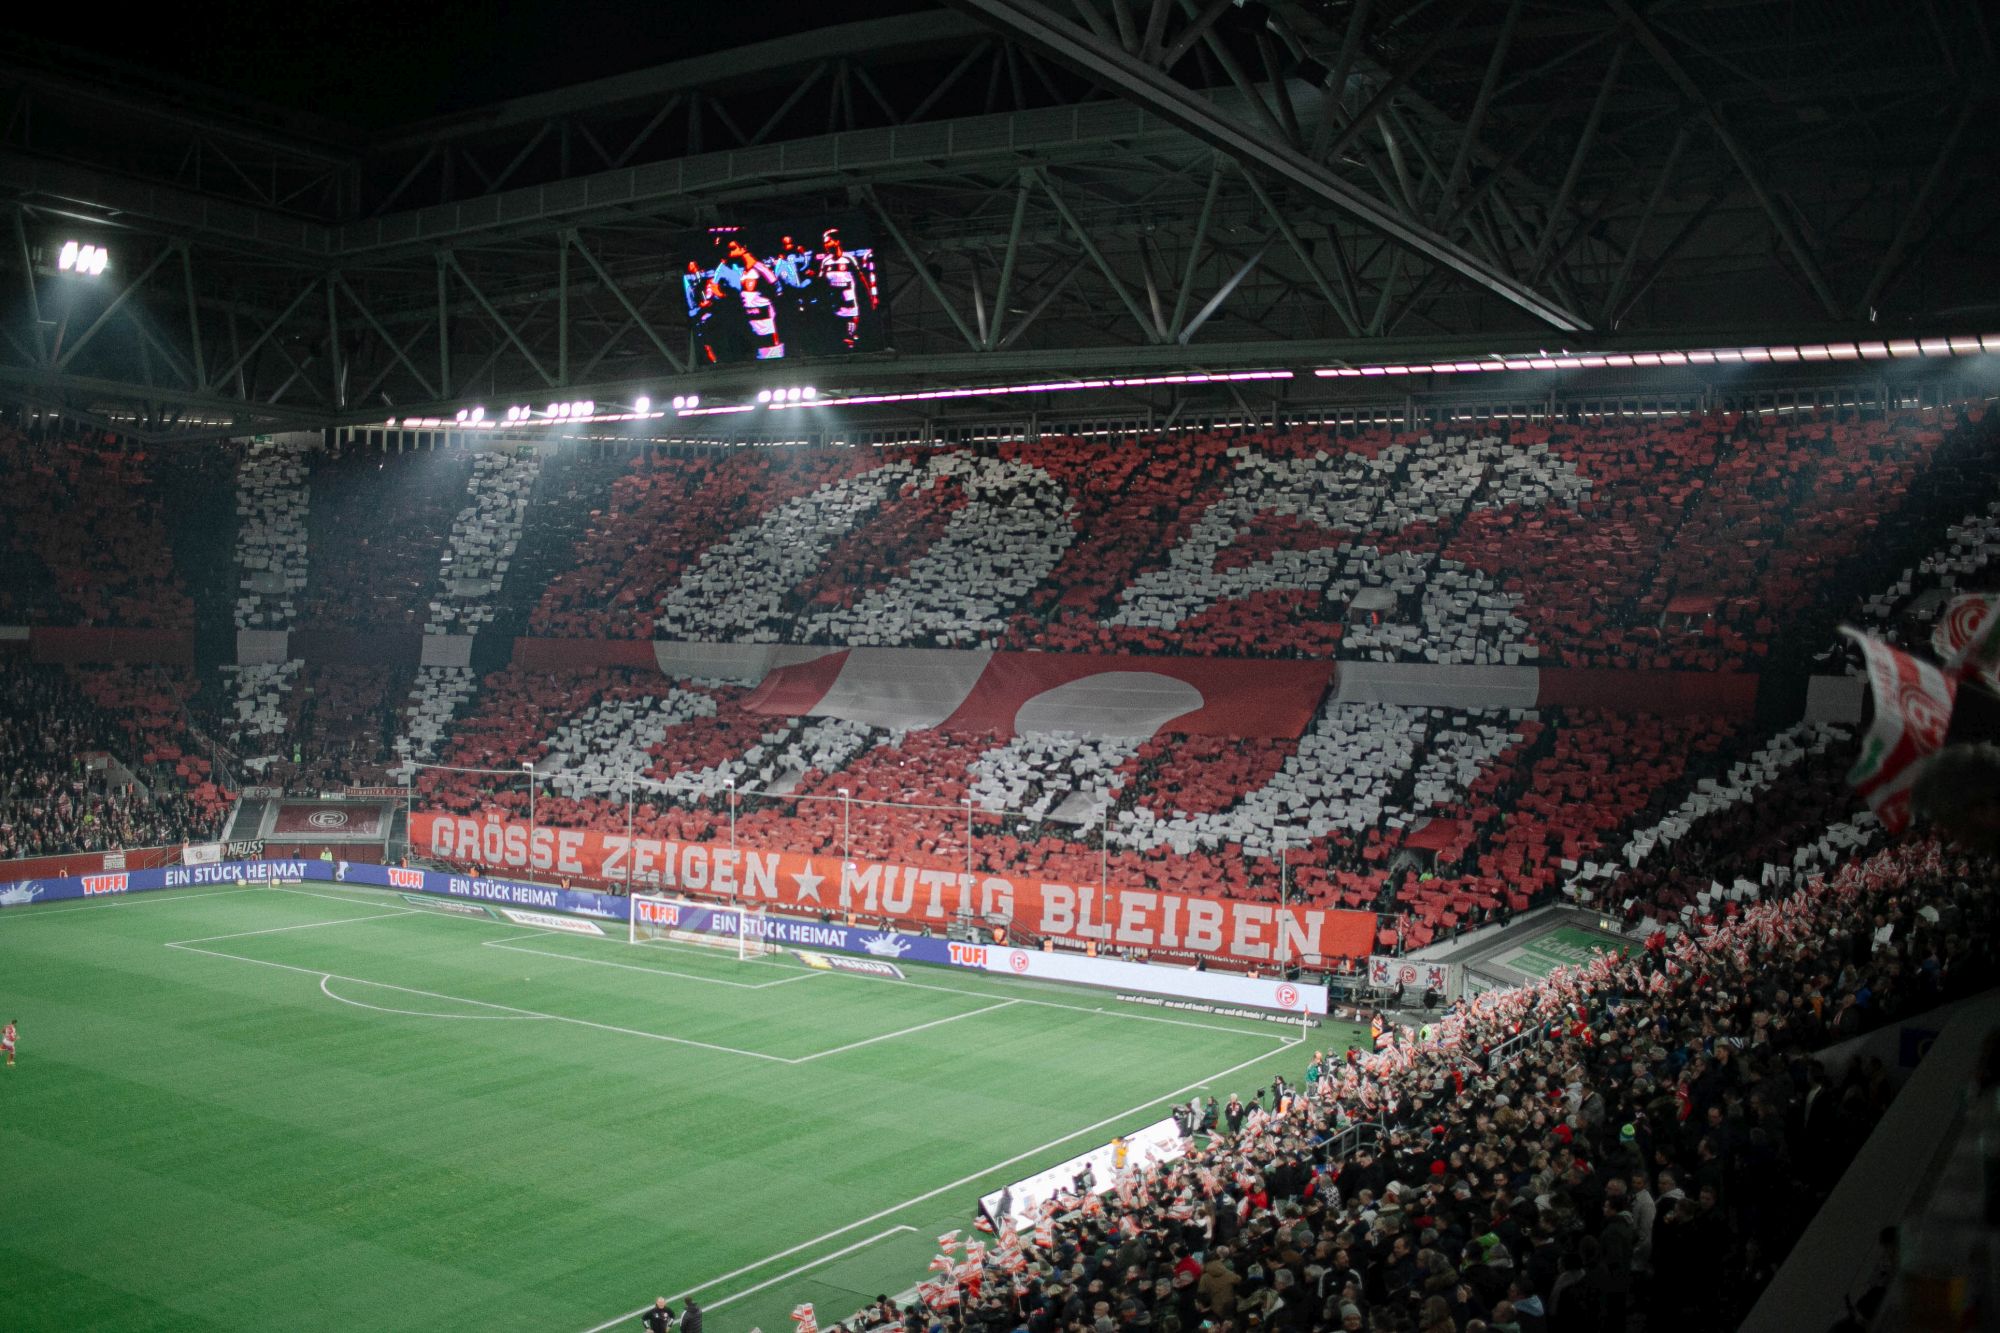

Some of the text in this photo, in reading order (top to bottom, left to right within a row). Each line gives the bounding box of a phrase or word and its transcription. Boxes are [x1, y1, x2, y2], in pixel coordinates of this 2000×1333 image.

[227, 840, 264, 856] NEUSS
[81, 873, 129, 895] TUFFI
[164, 871, 190, 886] EIN
[194, 864, 243, 882] STÜCK
[246, 863, 307, 879] HEIMAT
[388, 868, 424, 889] TUFFI
[431, 814, 1325, 965] GRÖSSE ZEIGEN MUTIG BLEIBEN
[449, 879, 559, 907] EIN STÜCK HEIMAT
[638, 901, 679, 925] TUFFI
[712, 914, 737, 932] EIN
[742, 918, 787, 939] STÜCK
[790, 927, 848, 947] HEIMAT
